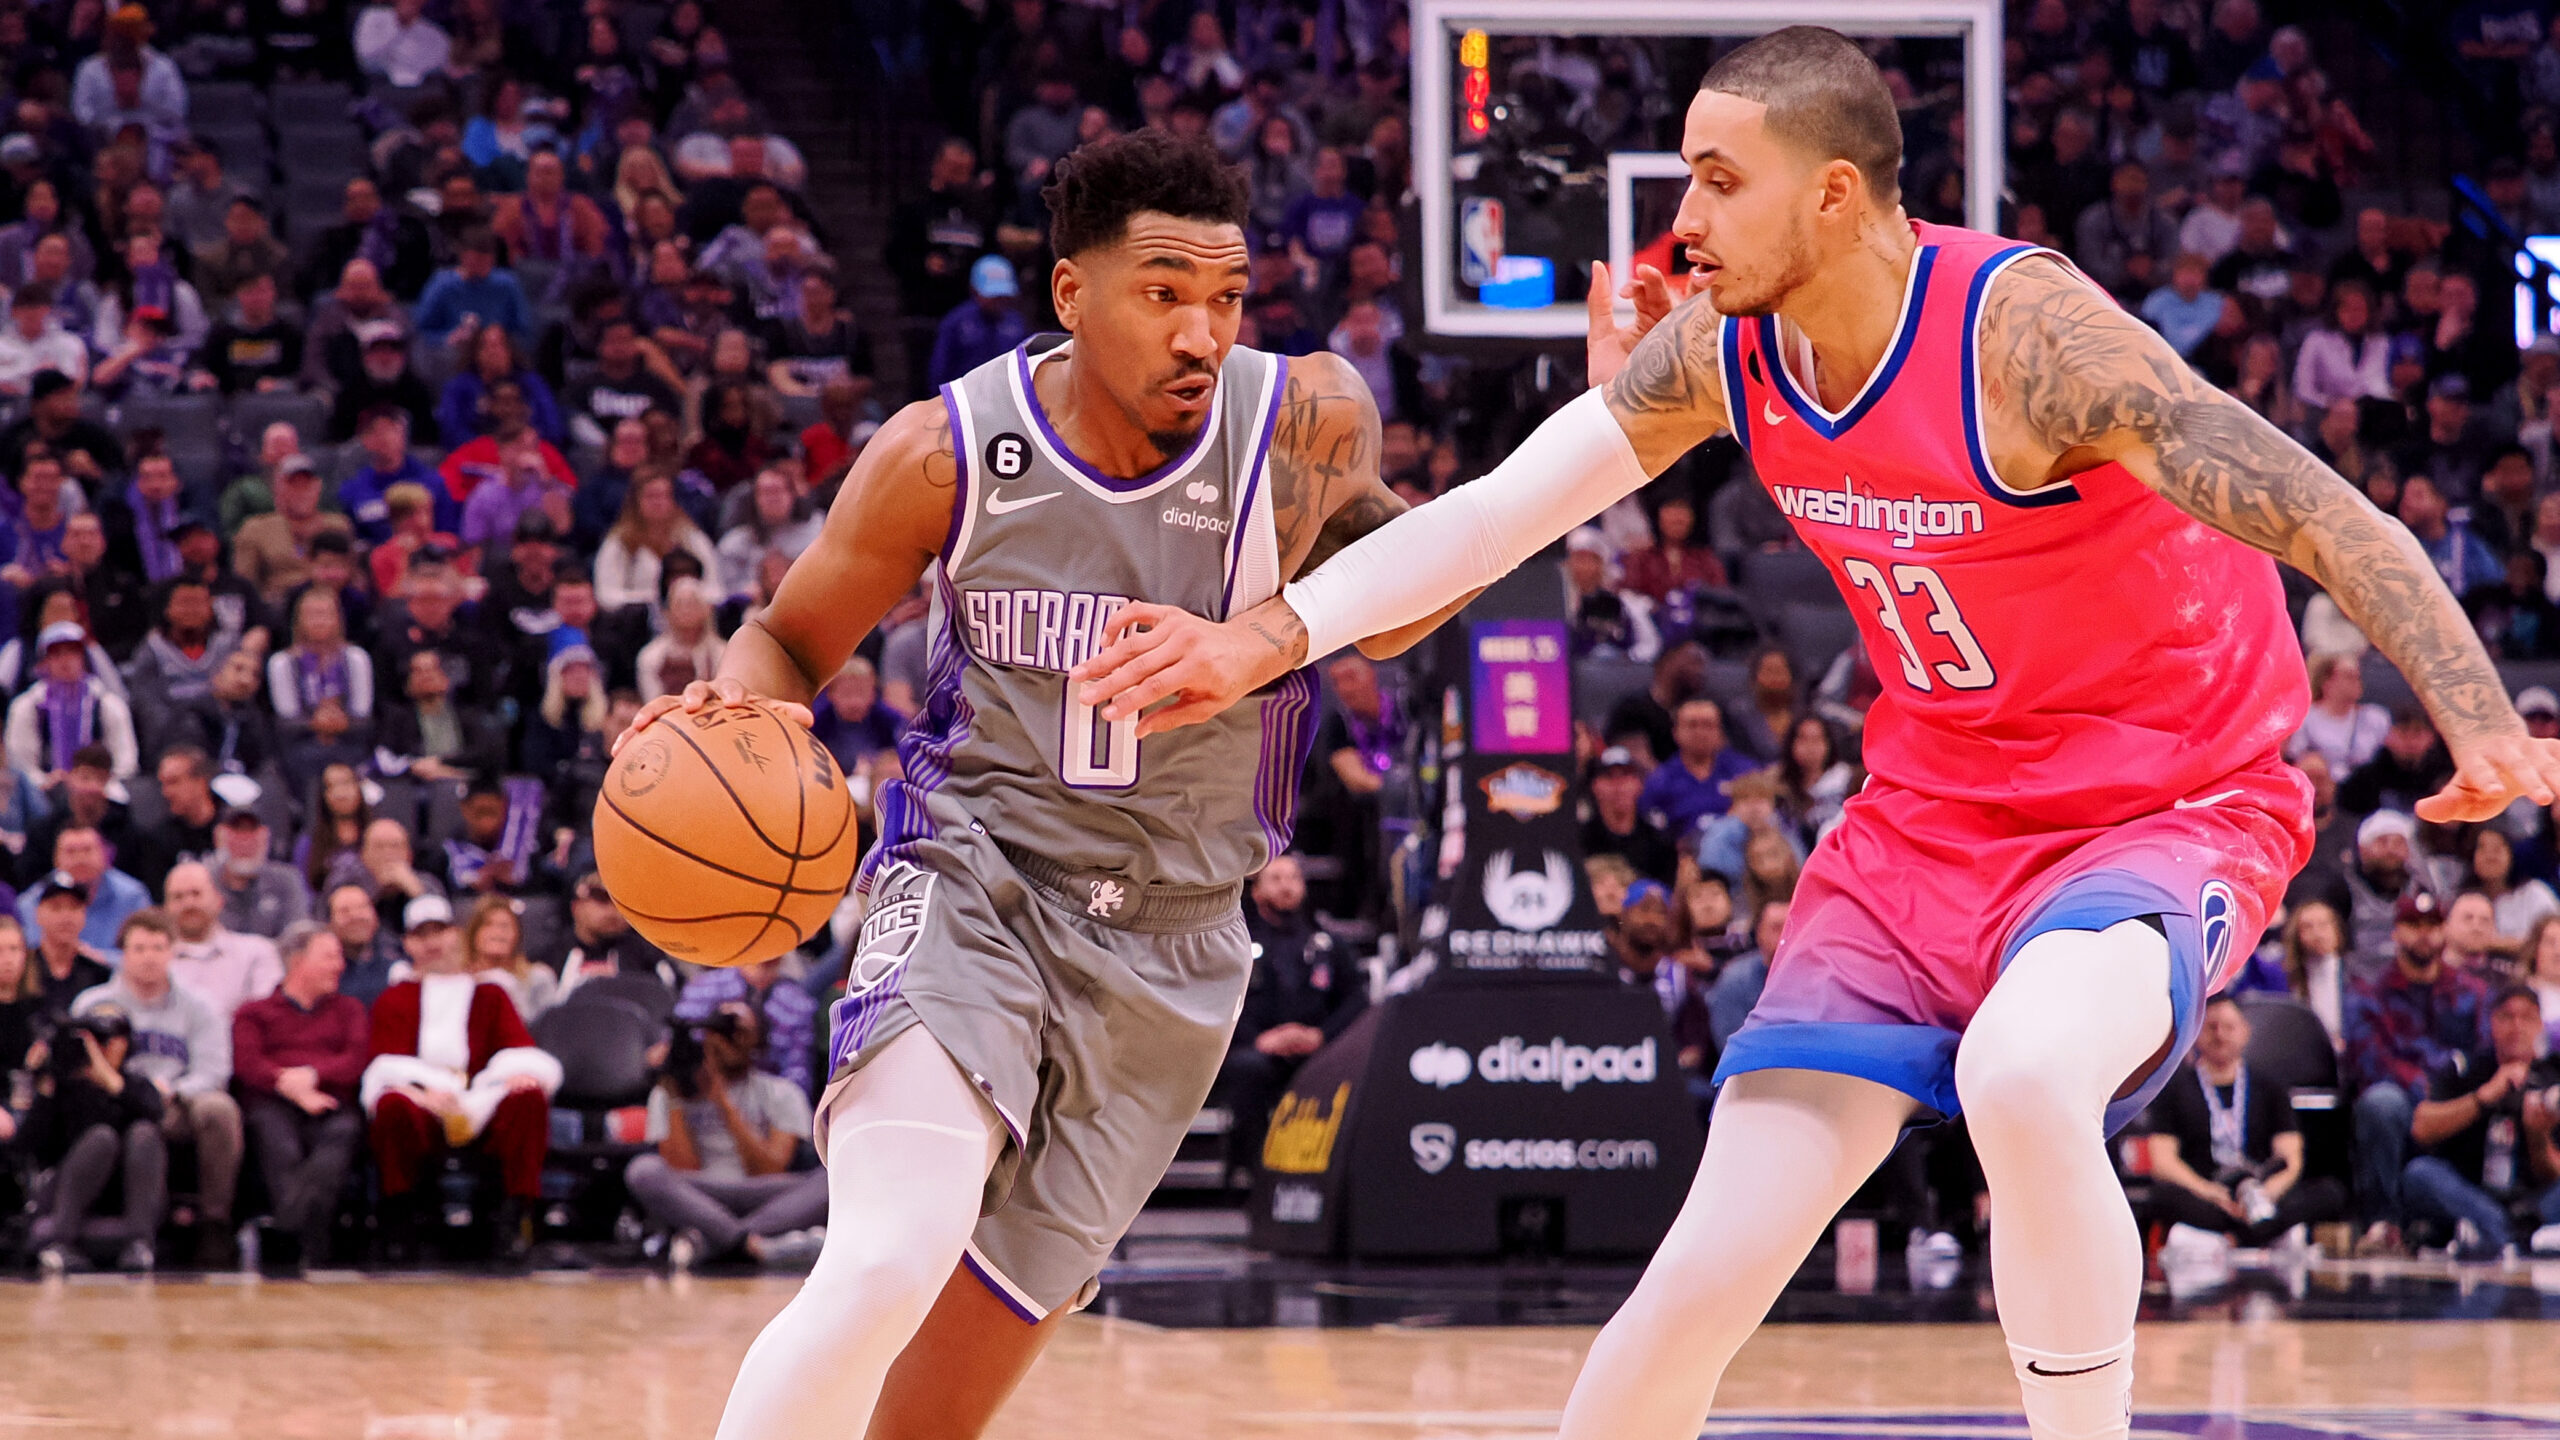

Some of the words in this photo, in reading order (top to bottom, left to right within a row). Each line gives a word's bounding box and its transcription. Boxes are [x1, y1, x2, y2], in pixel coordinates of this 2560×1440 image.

[995, 439, 1022, 475] 6
[1162, 506, 1230, 534] dialpad
[1773, 473, 1985, 549] washington
[963, 589, 1138, 673] SACRAM
[1843, 556, 1998, 694] 33
[1477, 1036, 1657, 1092] dialpad
[1464, 1137, 1658, 1170] socios.com
